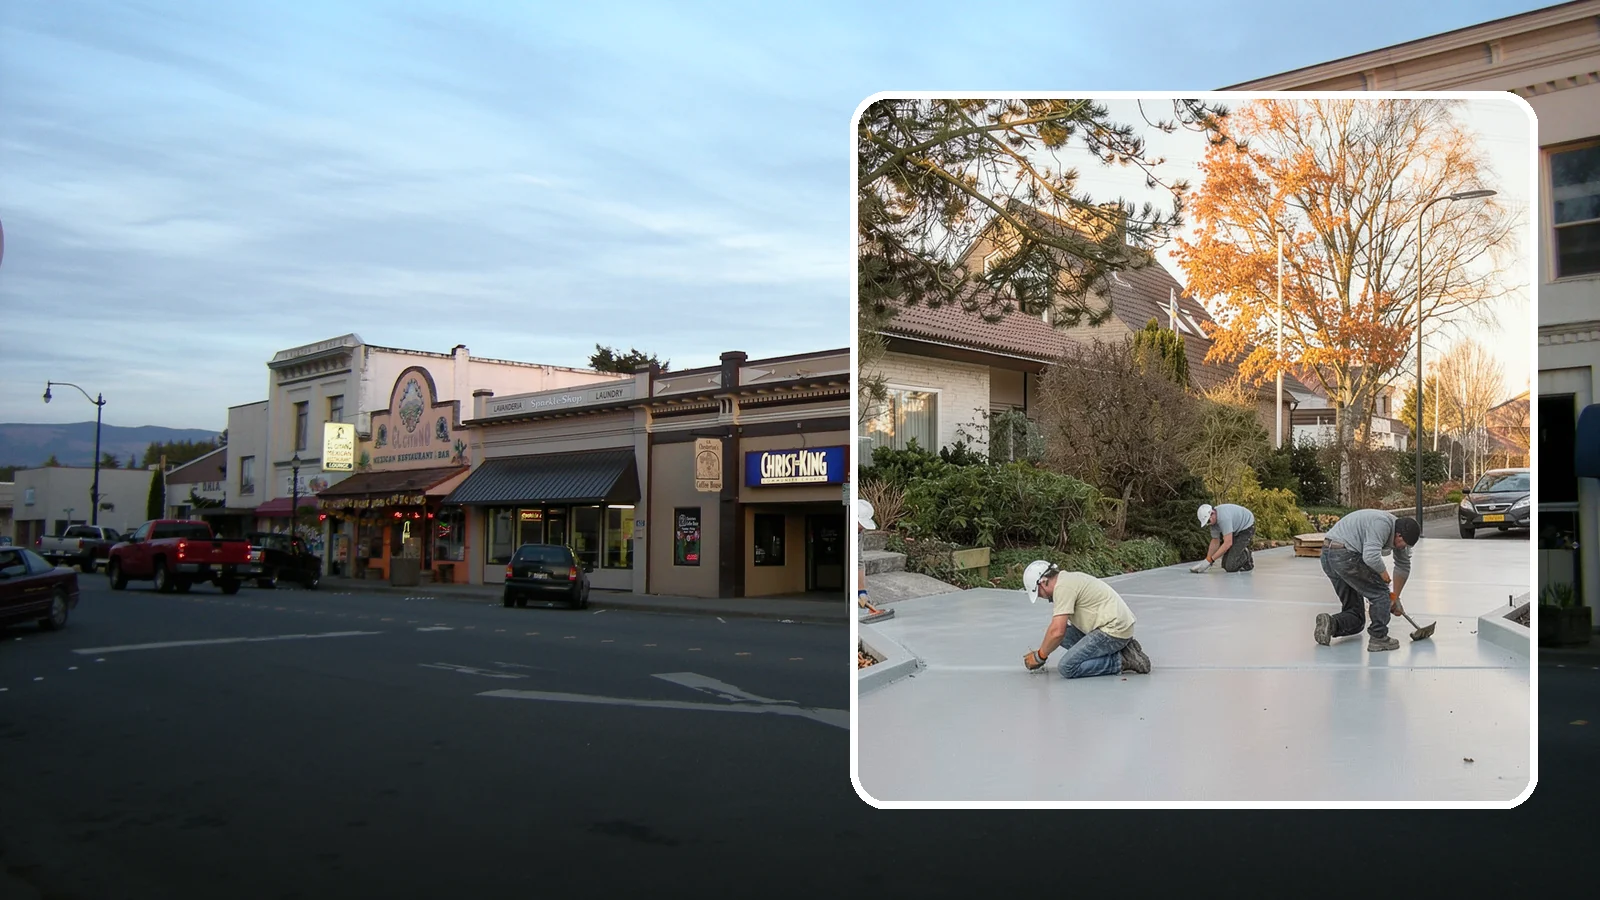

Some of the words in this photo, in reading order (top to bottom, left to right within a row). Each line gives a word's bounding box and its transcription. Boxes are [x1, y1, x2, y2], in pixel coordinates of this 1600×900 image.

[595, 389, 624, 400] LAUNDRY
[493, 402, 523, 412] LAVANDERIA
[530, 396, 561, 410] Sparkle
[561, 394, 582, 407] Shop
[374, 455, 396, 464] MEXICAN
[398, 452, 433, 462] RESTAURANT
[437, 450, 450, 459] BAR
[760, 452, 797, 478] CHRIST
[799, 450, 828, 476] KING
